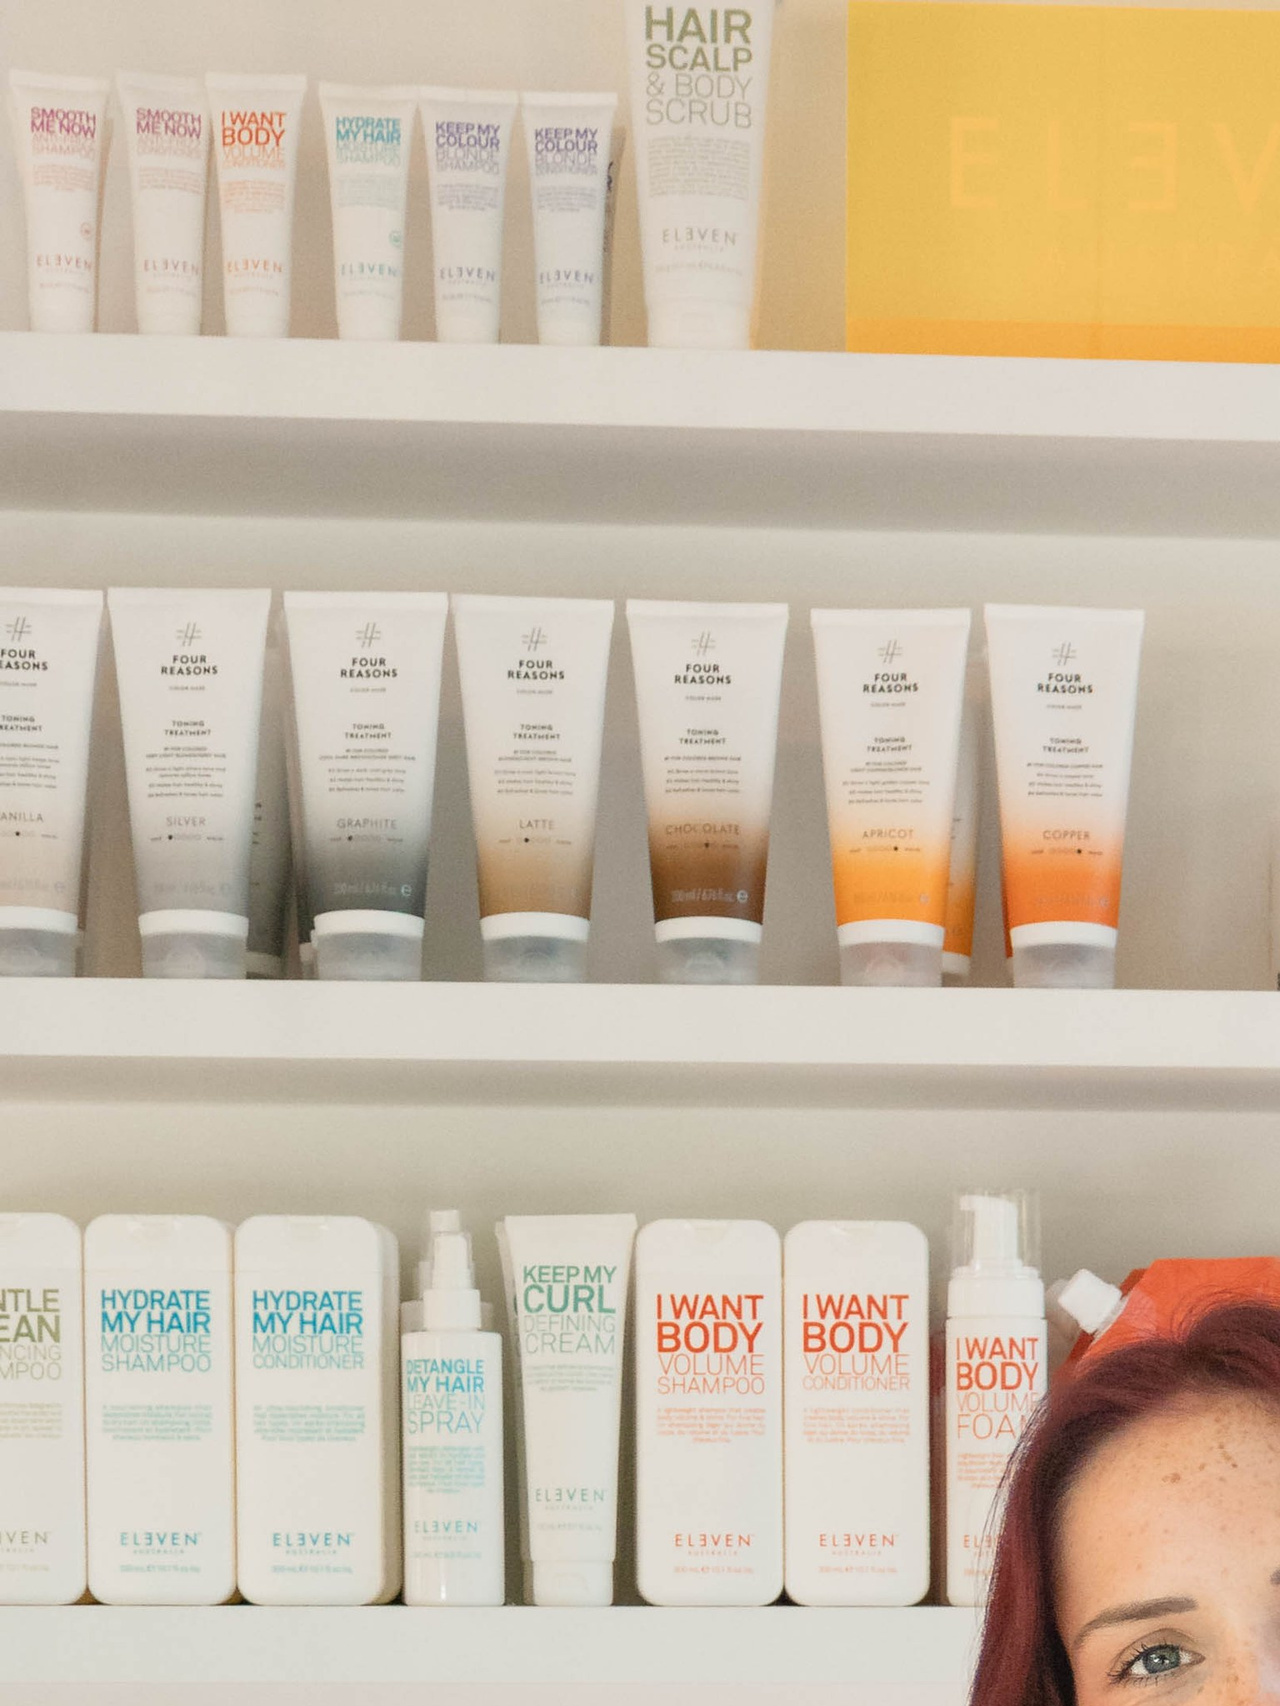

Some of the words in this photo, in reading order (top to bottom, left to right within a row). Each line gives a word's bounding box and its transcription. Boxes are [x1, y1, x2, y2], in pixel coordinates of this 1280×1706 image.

[645, 5, 752, 44] HAIR
[645, 43, 753, 73] SCALP
[646, 72, 665, 97] &
[675, 72, 753, 100] BODY
[30, 107, 96, 124] SMOOTH
[136, 108, 200, 125] SMOOTH
[238, 111, 287, 128] WANT
[645, 98, 752, 129] SCRUB
[30, 119, 55, 135] ME
[59, 121, 96, 138] NOW
[136, 120, 160, 135] ME
[164, 122, 201, 139] NOW
[336, 116, 401, 132] HYDRATE
[435, 121, 473, 136] KEEP
[477, 123, 500, 137] MY
[221, 128, 285, 147] BODY
[336, 129, 361, 144] MY
[364, 130, 401, 145] HAIR
[435, 134, 500, 151] COLOUR
[534, 127, 572, 142] KEEP
[576, 127, 598, 141] MY
[534, 138, 598, 154] COLOUR
[0, 648, 36, 660] FOUR
[172, 654, 207, 665] FOUR
[351, 656, 386, 668] FOUR
[0, 659, 48, 671] EASONS
[160, 664, 218, 676] REASONS
[518, 658, 553, 670] FOUR
[685, 662, 720, 674] FOUR
[340, 667, 398, 679] REASONS
[507, 669, 565, 681] REASONS
[674, 673, 732, 685] REASONS
[873, 672, 907, 683] FOUR
[1047, 672, 1082, 684] FOUR
[862, 682, 919, 694] REASONS
[1036, 682, 1093, 695] REASONS
[0, 811, 44, 824] ANILLA
[166, 815, 206, 828] SILVER
[336, 817, 397, 830] GRAPHITE
[519, 818, 555, 831] LATTE
[665, 822, 741, 837] CHOCOLATE
[862, 827, 914, 840] APRICOT
[1042, 829, 1091, 842] COPPER
[523, 1265, 580, 1284] KEEP
[583, 1265, 617, 1284] MY
[101, 1289, 210, 1311] HYDRATE
[252, 1290, 362, 1312] HYDRATE
[522, 1283, 616, 1314] CURL
[656, 1294, 662, 1320] I
[670, 1294, 764, 1320] WANT
[802, 1294, 808, 1320] I
[815, 1294, 909, 1320] WANT
[0, 1314, 61, 1343] EAN
[101, 1311, 139, 1334] MY
[147, 1311, 210, 1334] HAIR
[252, 1312, 292, 1335] MY
[300, 1312, 363, 1335] HAIR
[523, 1314, 615, 1333] DEFINING
[101, 1334, 211, 1353] MOISTURE
[252, 1334, 363, 1354] MOISTURE
[524, 1333, 615, 1355] CREAM
[657, 1321, 763, 1354] BODY
[802, 1321, 909, 1354] BODY
[967, 1337, 1038, 1361] WANT
[101, 1353, 212, 1373] SHAMPOO
[253, 1353, 364, 1370] CONDITIONER
[406, 1358, 485, 1376] DETANGLE
[658, 1353, 765, 1376] VOLUME
[803, 1353, 910, 1376] VOLUME
[406, 1375, 432, 1393] MY
[435, 1375, 485, 1393] HAIR
[802, 1376, 910, 1392] CONDITIONER
[956, 1361, 1038, 1391] BODY
[657, 1376, 765, 1395] SHAMPOO
[406, 1393, 485, 1412] LEAVE-IN
[407, 1410, 485, 1435] SPRAY
